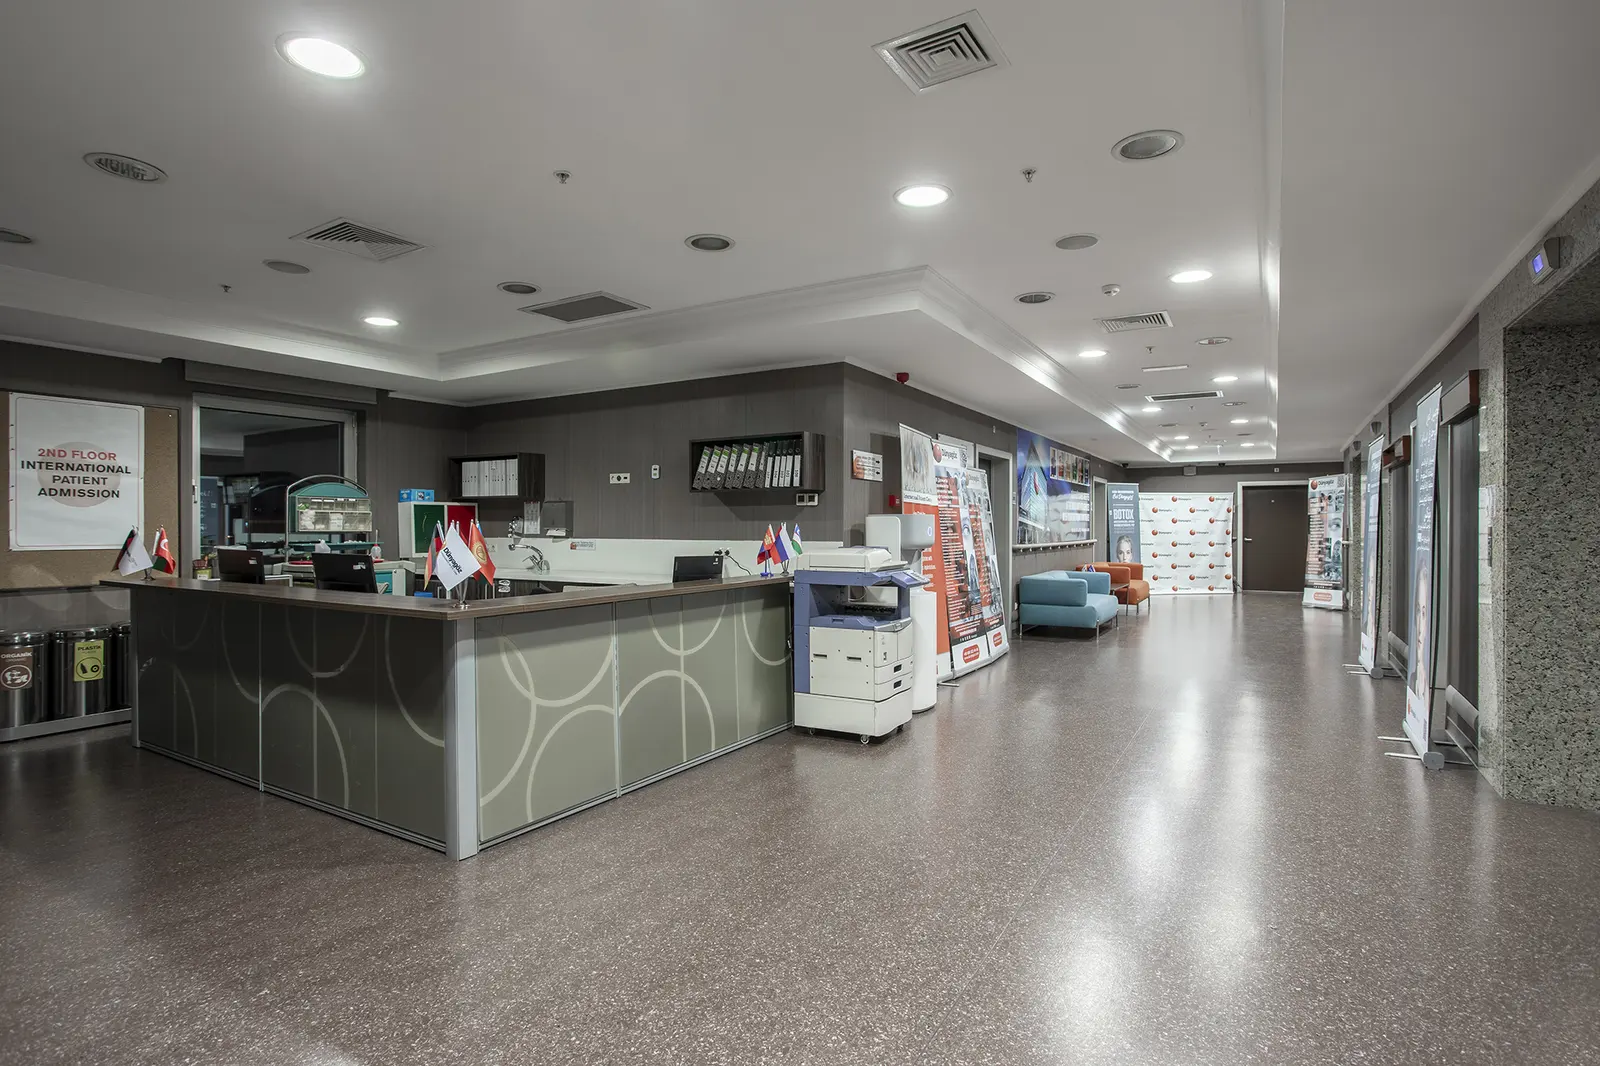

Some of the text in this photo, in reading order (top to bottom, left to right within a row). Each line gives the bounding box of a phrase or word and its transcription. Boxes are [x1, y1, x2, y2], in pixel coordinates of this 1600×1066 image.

[38, 448, 117, 461] 2ND FLOOR
[21, 460, 131, 474] INTERNATIONAL
[52, 475, 108, 485] PATIENT
[37, 488, 120, 498] ADMISSION
[1113, 509, 1135, 520] BOTOX
[443, 547, 463, 574] Dünyagöz
